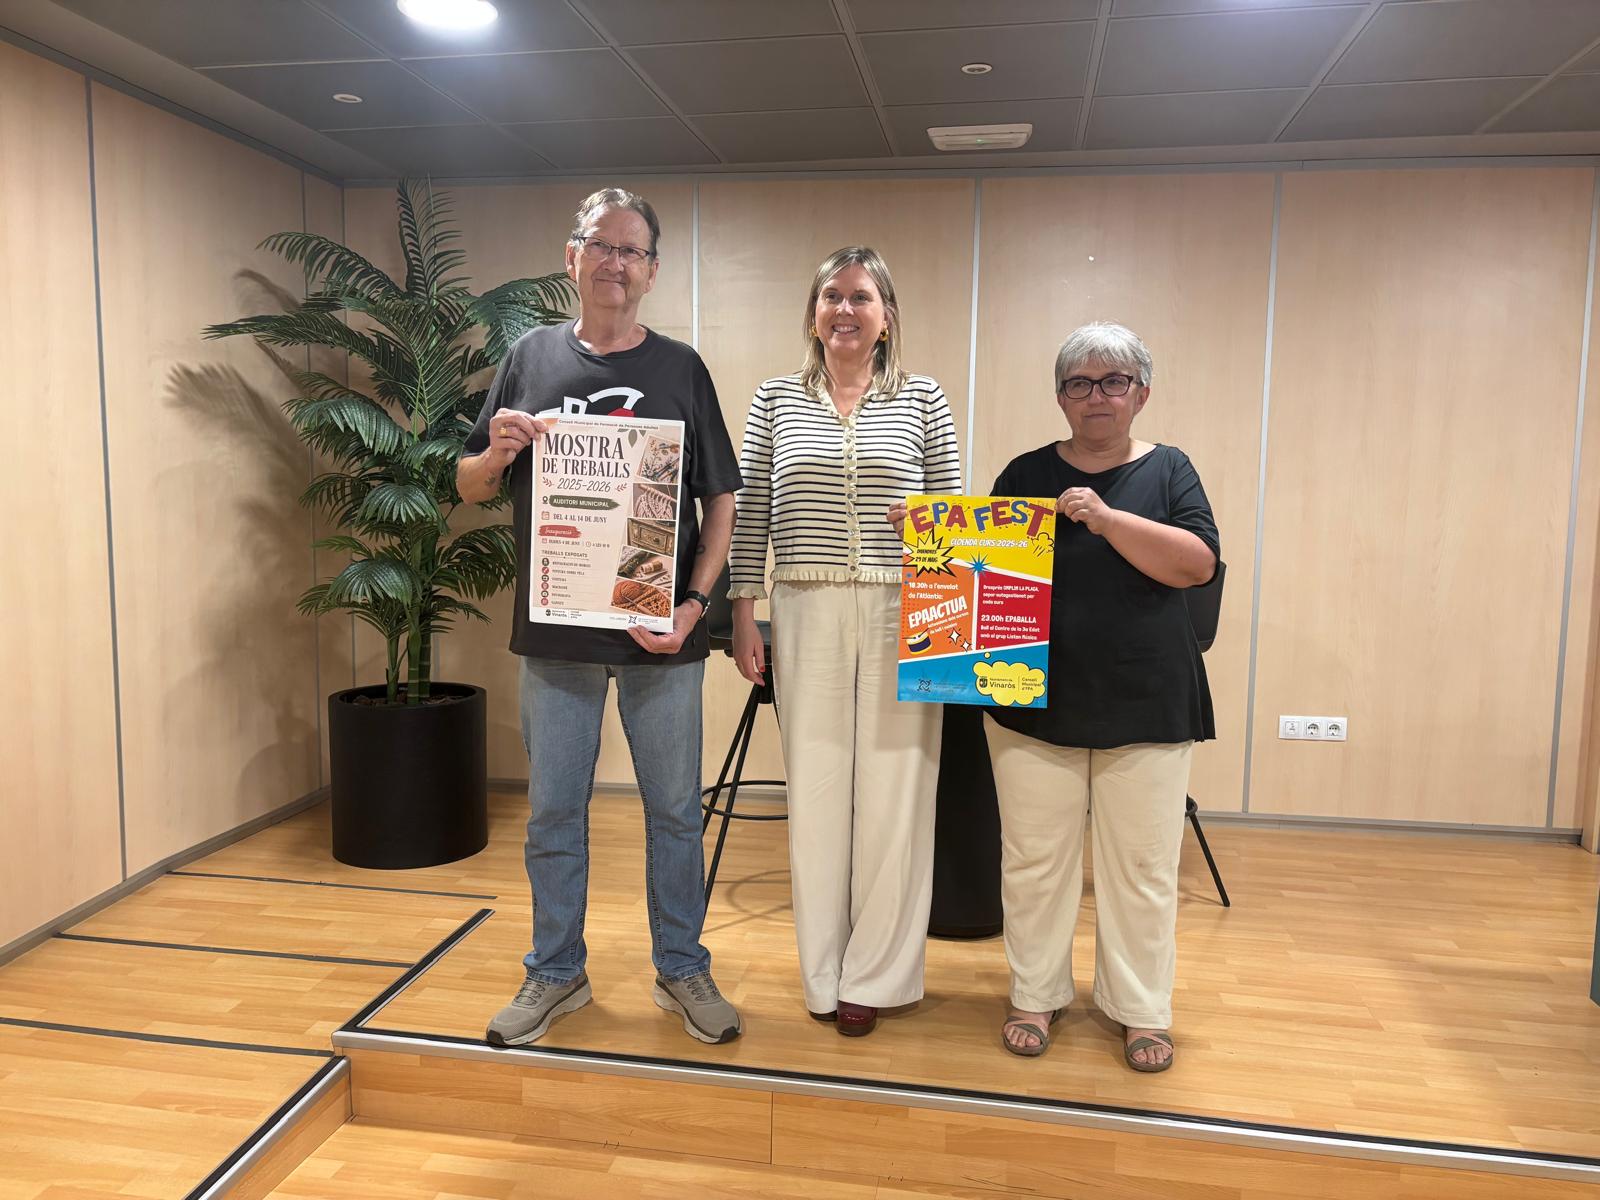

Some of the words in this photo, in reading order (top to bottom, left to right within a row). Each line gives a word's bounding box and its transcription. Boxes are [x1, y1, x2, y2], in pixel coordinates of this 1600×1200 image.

[544, 432, 624, 460] MOSTRA
[542, 458, 558, 474] DE
[562, 458, 630, 478] TREBALLS
[557, 478, 611, 492] 2025-2026
[908, 501, 968, 534] EPA
[973, 500, 1054, 538] FEST
[951, 538, 978, 546] CLOENDA
[979, 539, 996, 547] CURS
[996, 540, 1028, 548] 2025-26
[908, 594, 968, 628] EPAACTUA
[1005, 616, 1036, 624] EPABALLA
